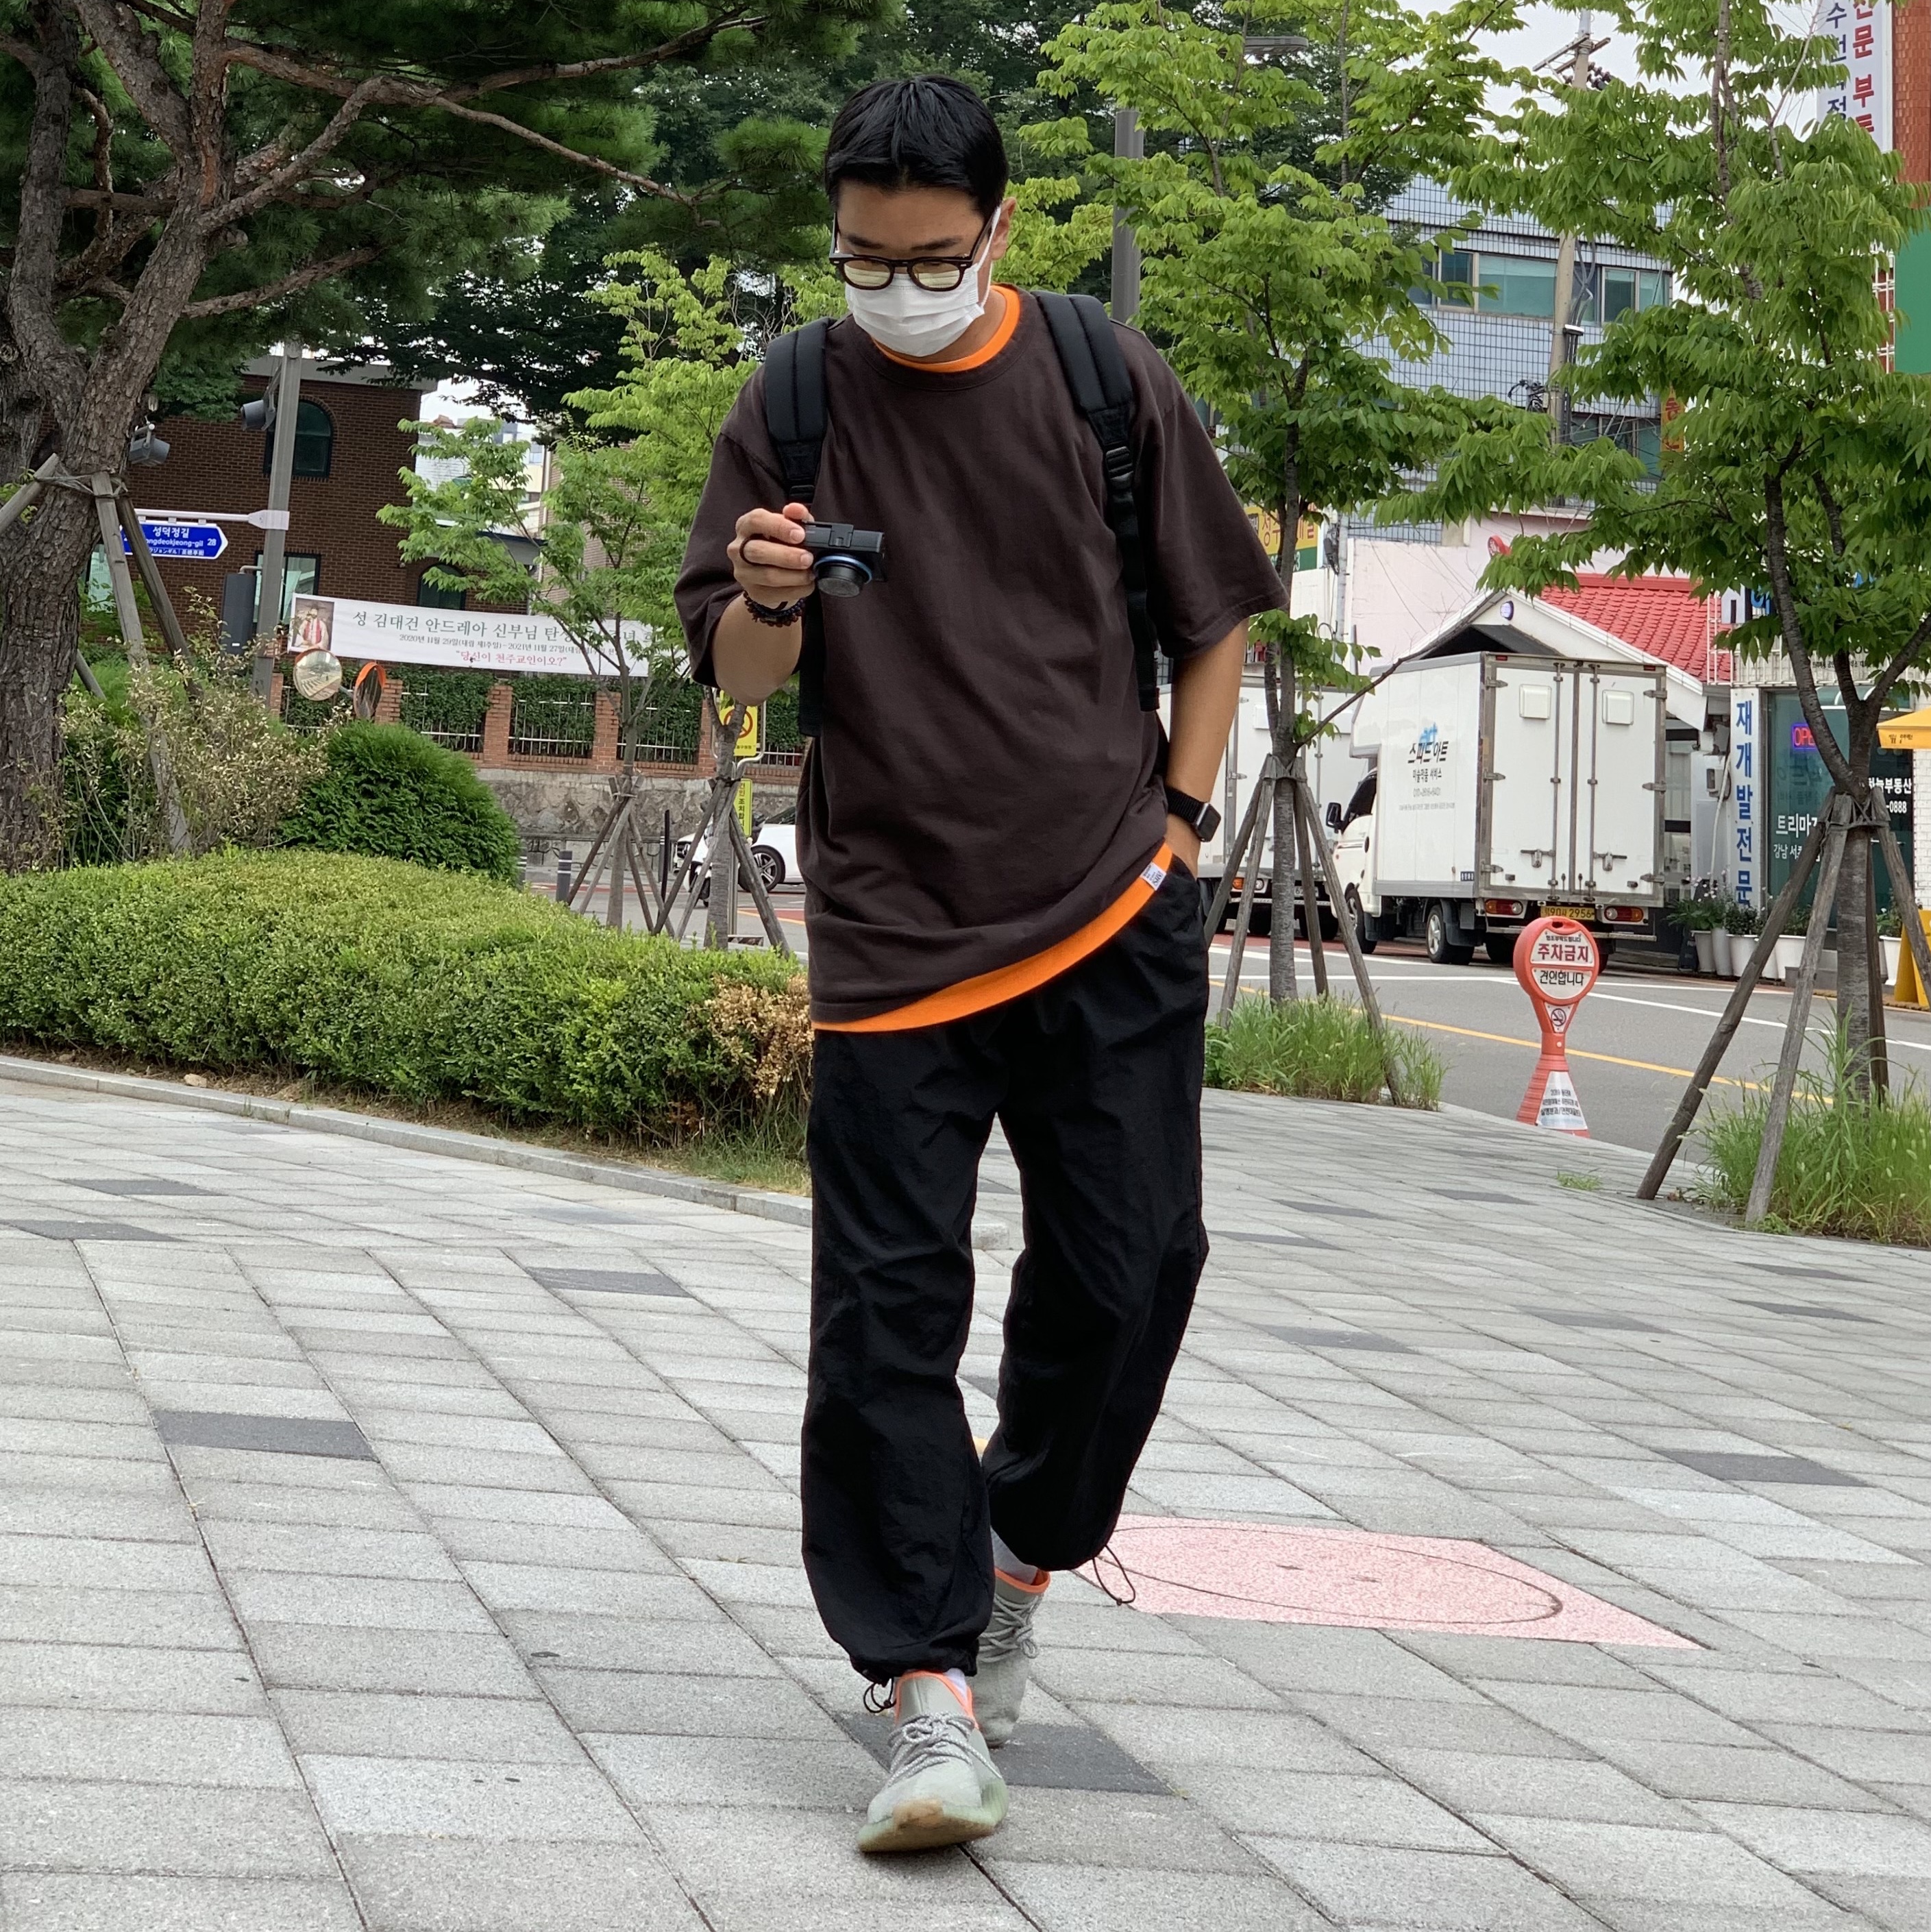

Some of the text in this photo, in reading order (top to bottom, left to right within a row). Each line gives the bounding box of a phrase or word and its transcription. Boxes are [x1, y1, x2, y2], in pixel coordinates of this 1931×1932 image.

[153, 526, 189, 538] 성덕정길
[146, 538, 217, 548] ongdeokjeong-gil 28
[353, 611, 367, 626] 성
[373, 613, 419, 631] 김대건
[426, 618, 488, 637] 안드레아
[493, 623, 537, 641] 신부님
[399, 634, 425, 644] 2020년
[427, 636, 440, 645] 11월
[1795, 727, 1816, 746] OPE
[1408, 741, 1449, 764] 스피드아트
[1773, 844, 1788, 859] 강남
[1569, 909, 1592, 918] 2956
[1538, 943, 1588, 962] 주차금지
[1540, 970, 1584, 986] 견인합니다
